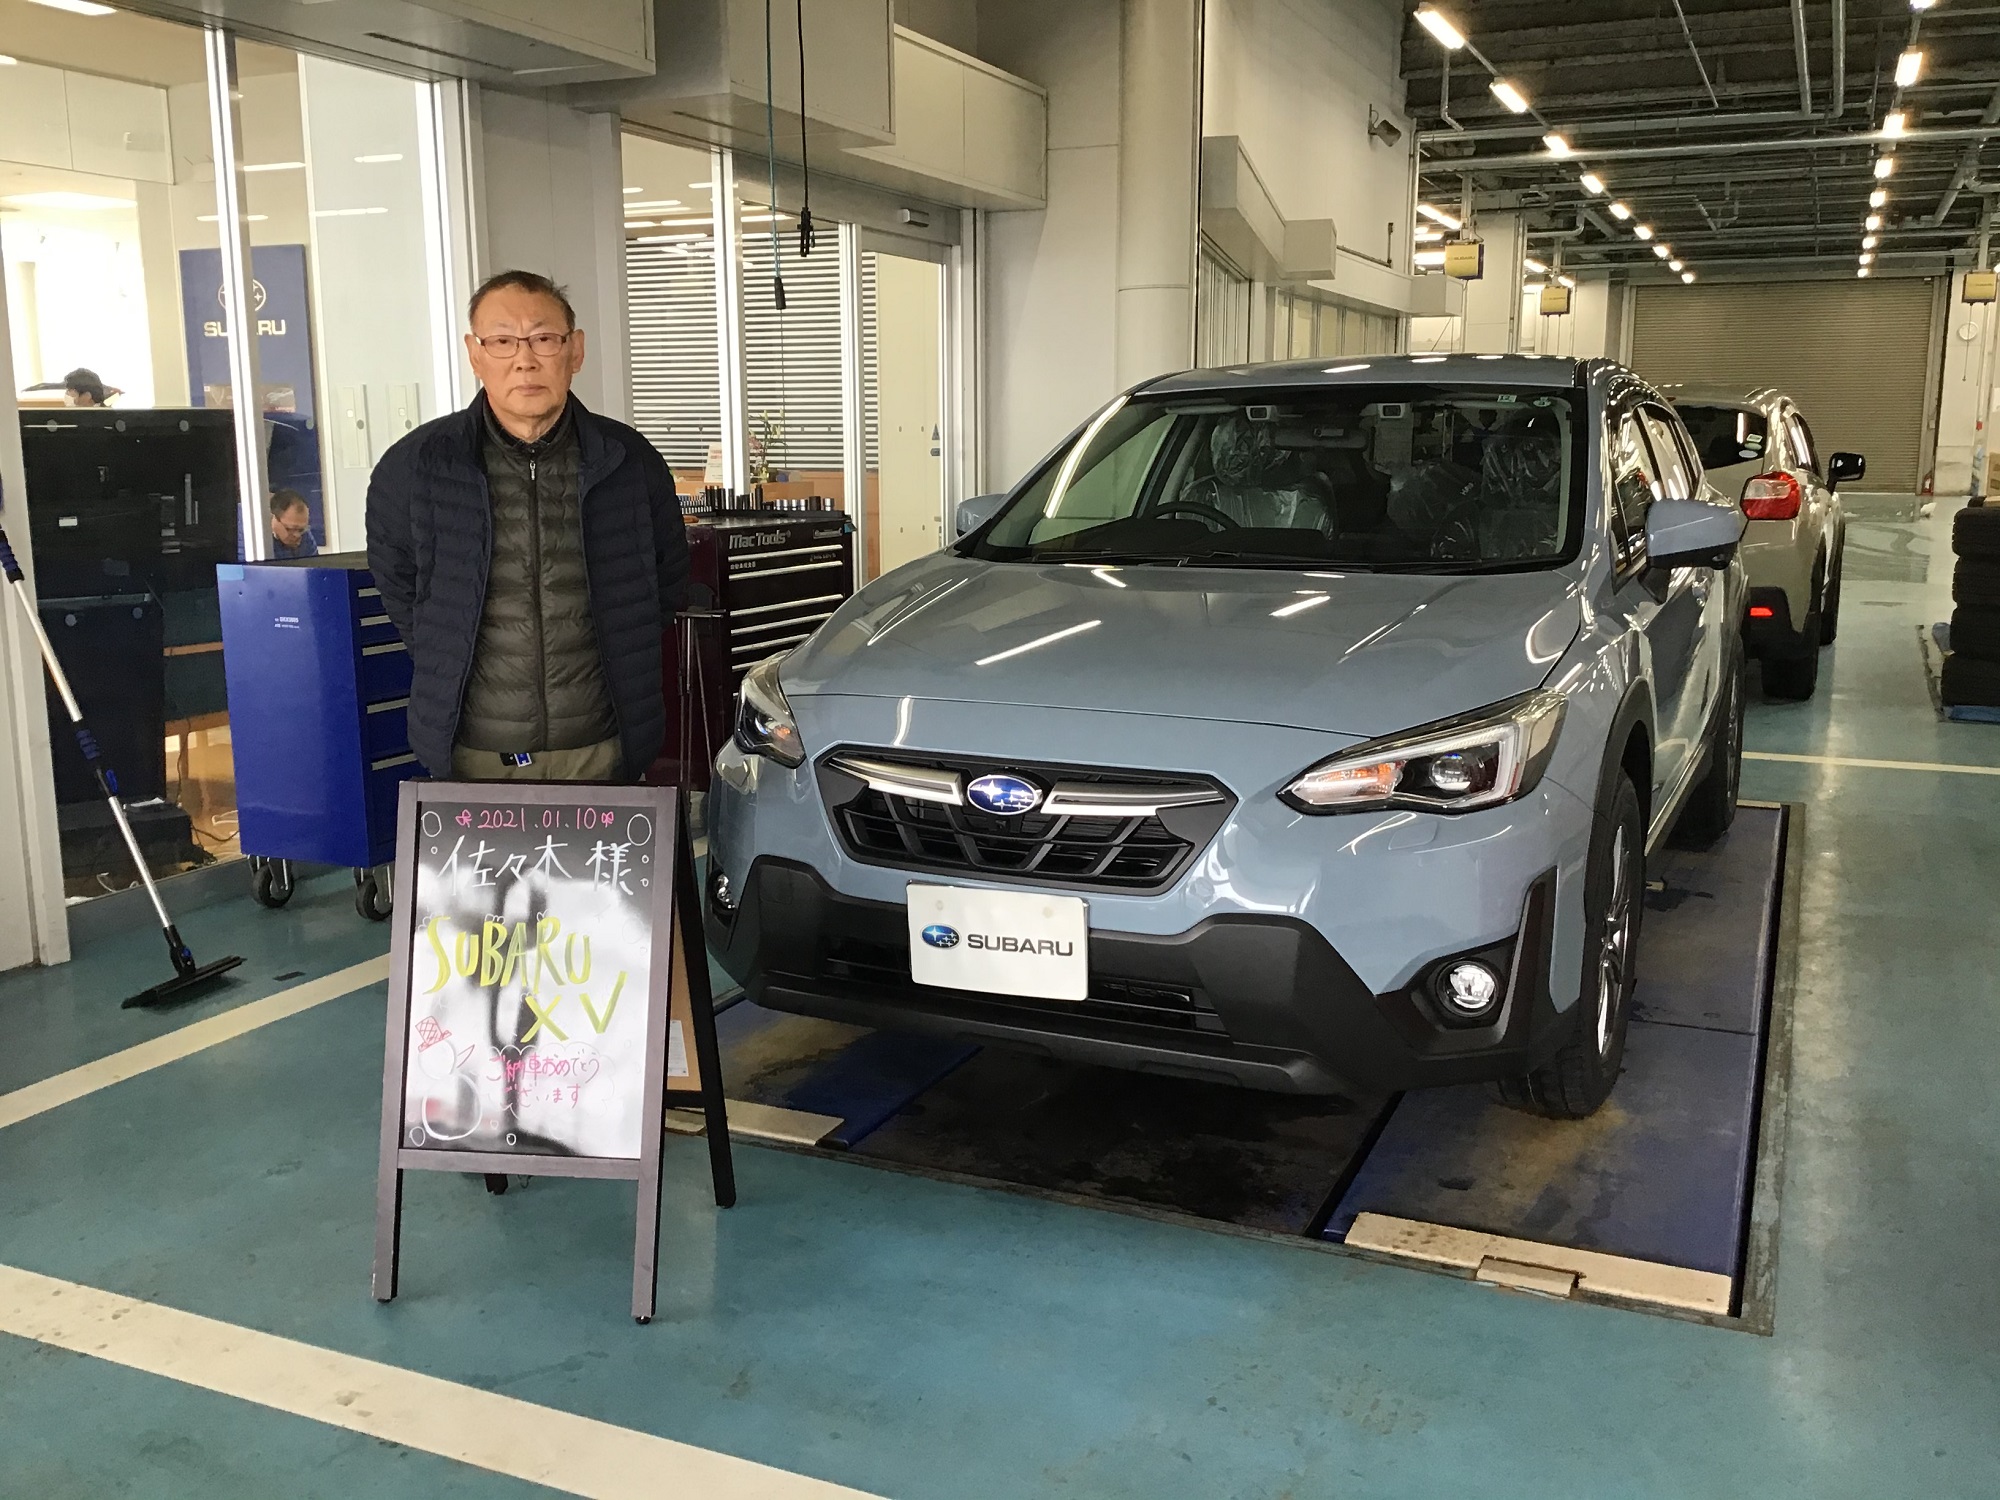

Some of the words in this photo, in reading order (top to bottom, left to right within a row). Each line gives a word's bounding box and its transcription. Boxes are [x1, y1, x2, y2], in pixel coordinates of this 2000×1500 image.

[203, 319, 286, 337] SURU
[477, 807, 597, 832] 2021.01.10
[436, 835, 573, 896] 佐々木
[585, 840, 634, 896] 様
[422, 916, 592, 995] SUBARU
[967, 933, 1074, 957] SUBARU
